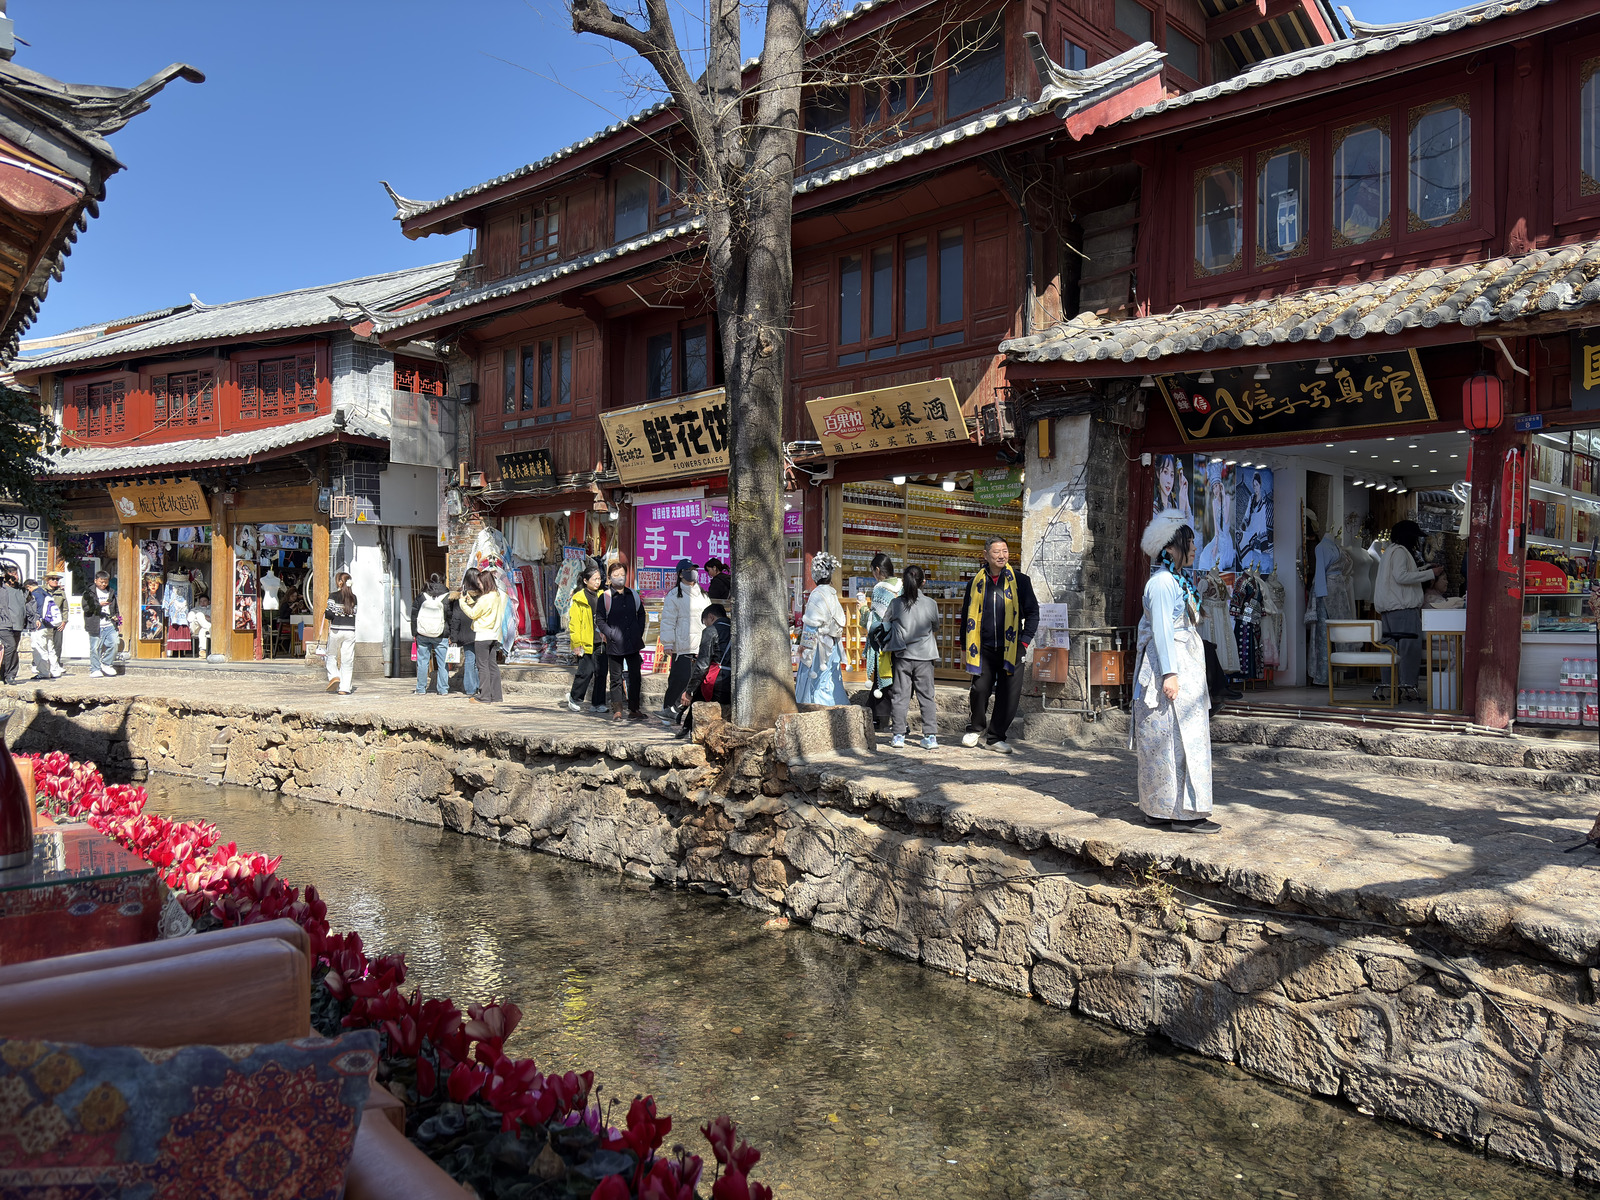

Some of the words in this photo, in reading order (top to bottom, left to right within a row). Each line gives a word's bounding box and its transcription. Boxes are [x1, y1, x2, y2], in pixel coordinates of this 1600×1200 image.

[823, 411, 863, 436] 百果悦
[870, 397, 949, 430] 花果酒
[833, 428, 957, 453] 丽江必买花果酒
[673, 459, 702, 470] FLOWERS
[703, 456, 724, 466] CAKES
